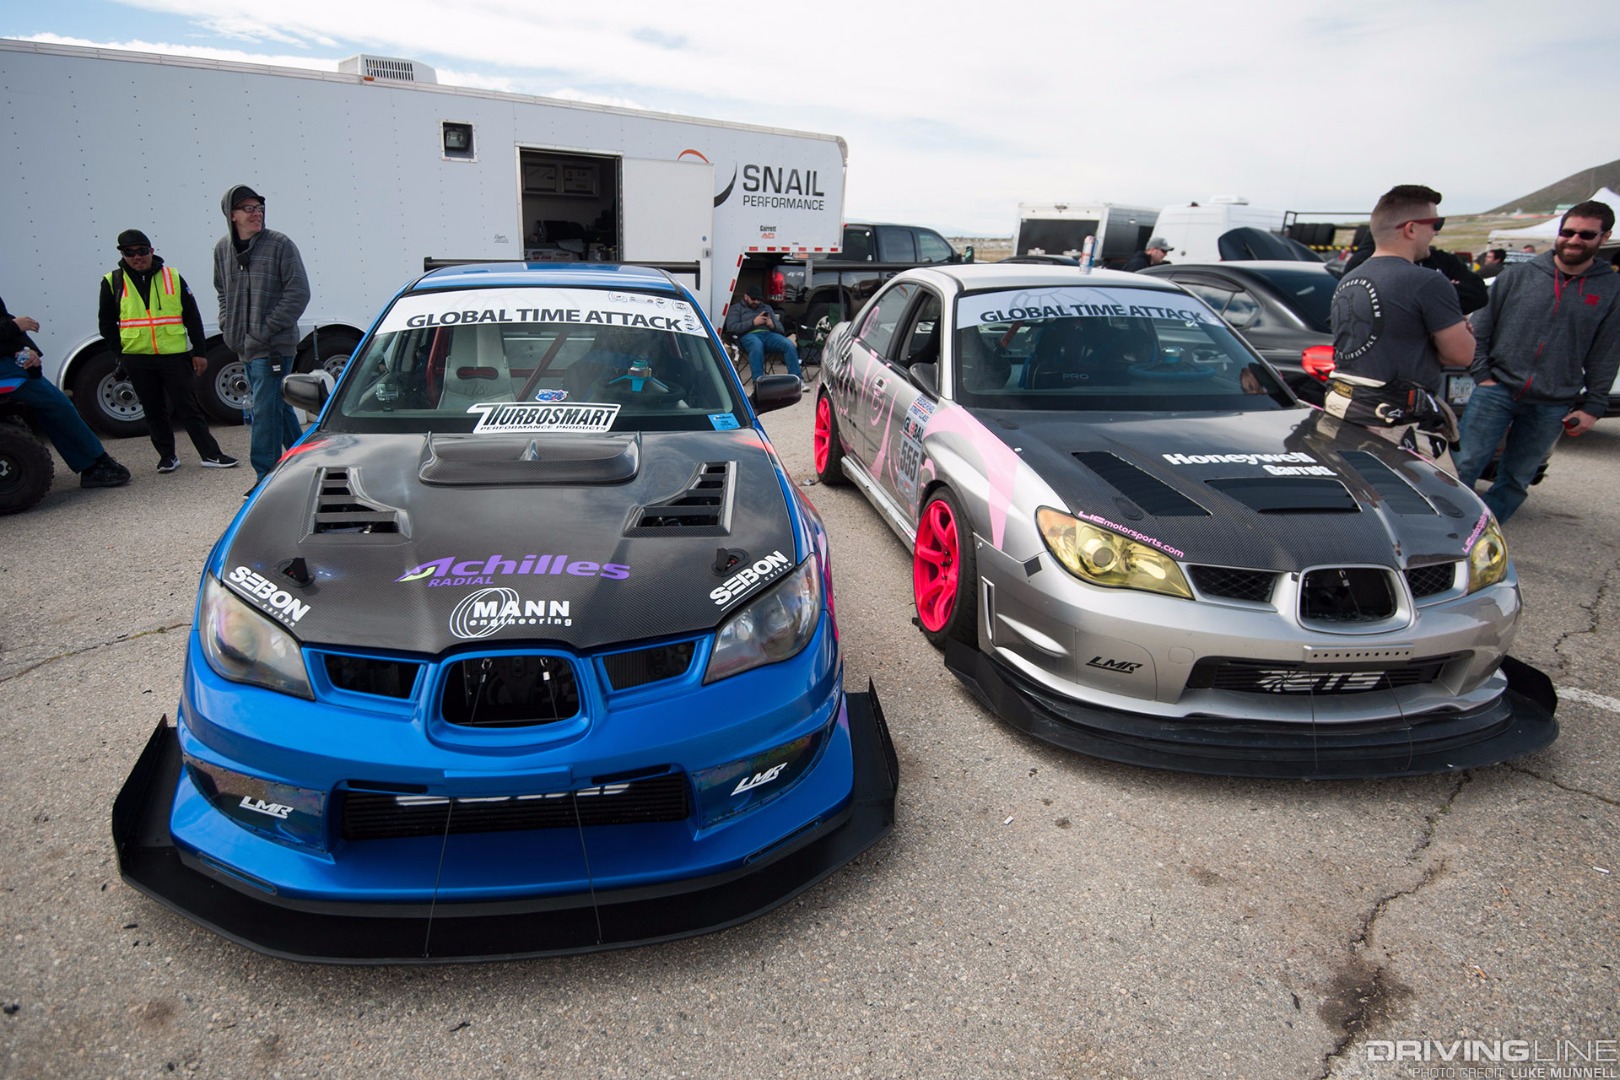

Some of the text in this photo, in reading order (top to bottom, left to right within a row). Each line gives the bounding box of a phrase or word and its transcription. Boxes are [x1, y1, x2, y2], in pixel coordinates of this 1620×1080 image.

[742, 164, 825, 197] SNAIL
[743, 195, 825, 211] PERFORMANCE
[406, 308, 513, 328] GLOBAL
[516, 308, 581, 323] TIME
[584, 310, 683, 332] ATTACK
[980, 304, 1207, 324] GLOBAL TIME ATTACK
[1062, 372, 1090, 381] PRO
[475, 404, 619, 426] TURBOSMART
[900, 440, 920, 482] 555
[1162, 452, 1318, 466] Honeywell
[1262, 464, 1338, 476] Garrett
[393, 554, 631, 583] Achilles
[428, 576, 495, 588] RADIAL
[262, 603, 296, 627] carbon
[473, 600, 570, 618] MANN
[469, 616, 572, 627] engineering
[1085, 656, 1143, 674] LMR
[730, 761, 788, 796] LMR
[239, 795, 295, 819] LMR
